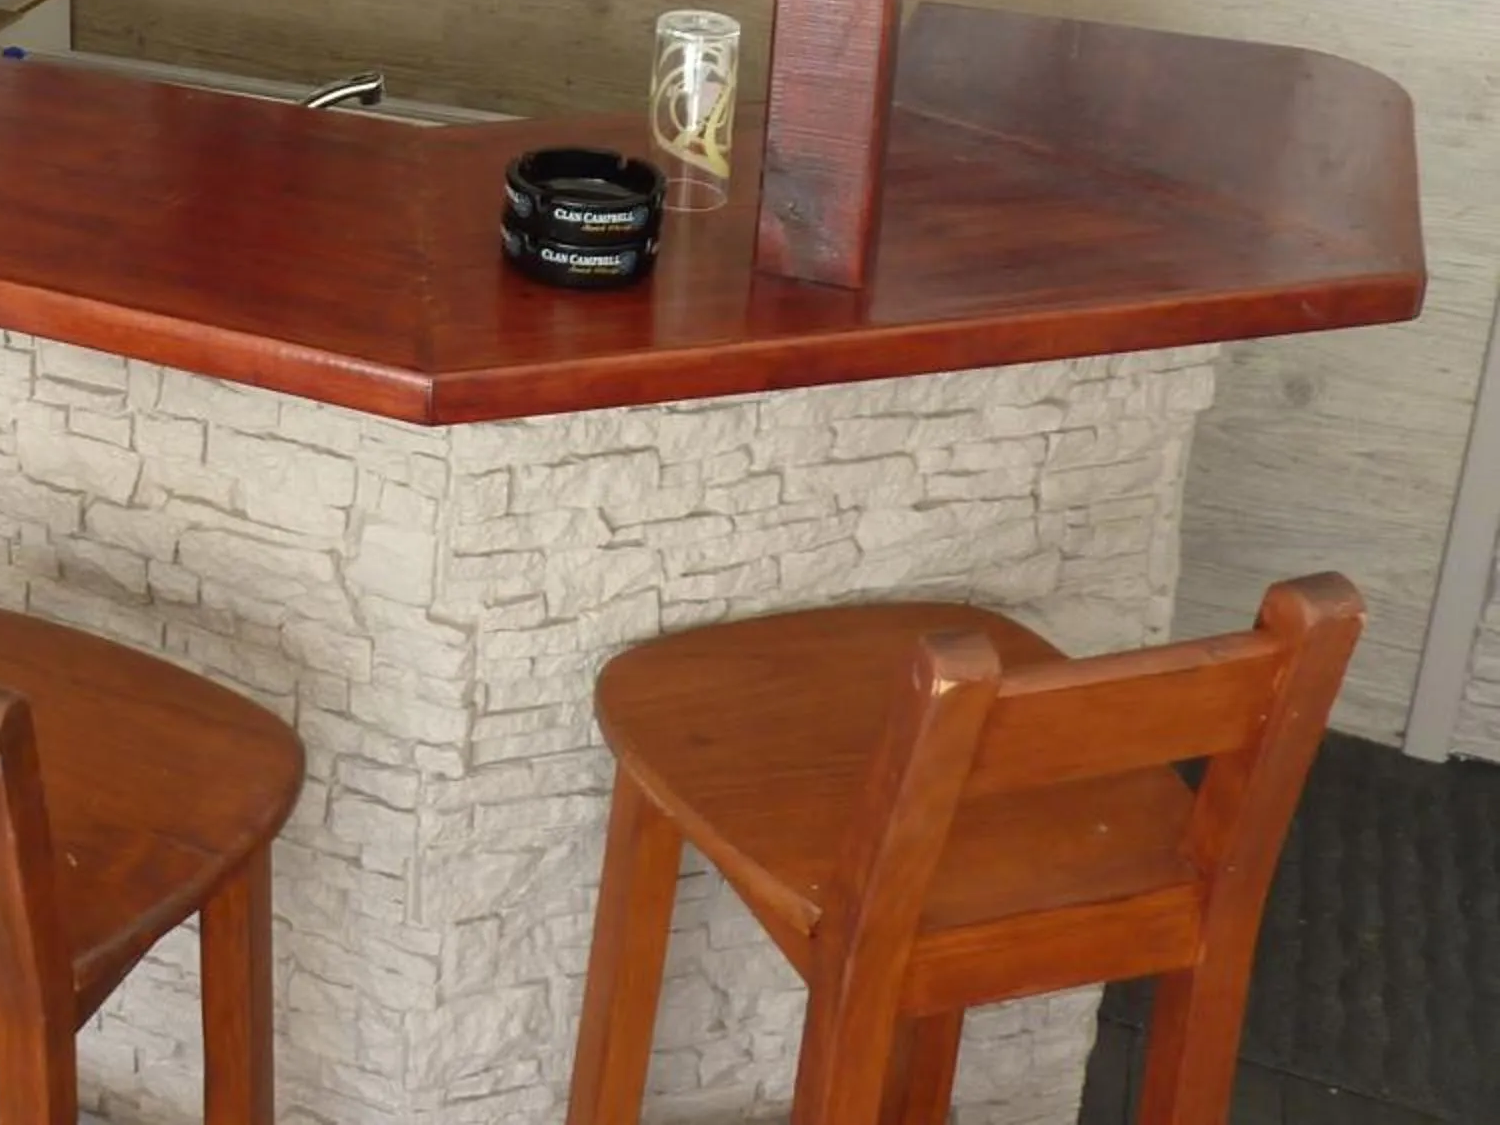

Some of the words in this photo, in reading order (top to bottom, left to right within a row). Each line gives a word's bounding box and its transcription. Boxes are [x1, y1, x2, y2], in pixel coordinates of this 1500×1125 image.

[554, 208, 581, 222] CLAN
[583, 211, 634, 224] CAMPBELL
[541, 248, 568, 263] CLAN
[569, 254, 621, 266] CAMPBELL
